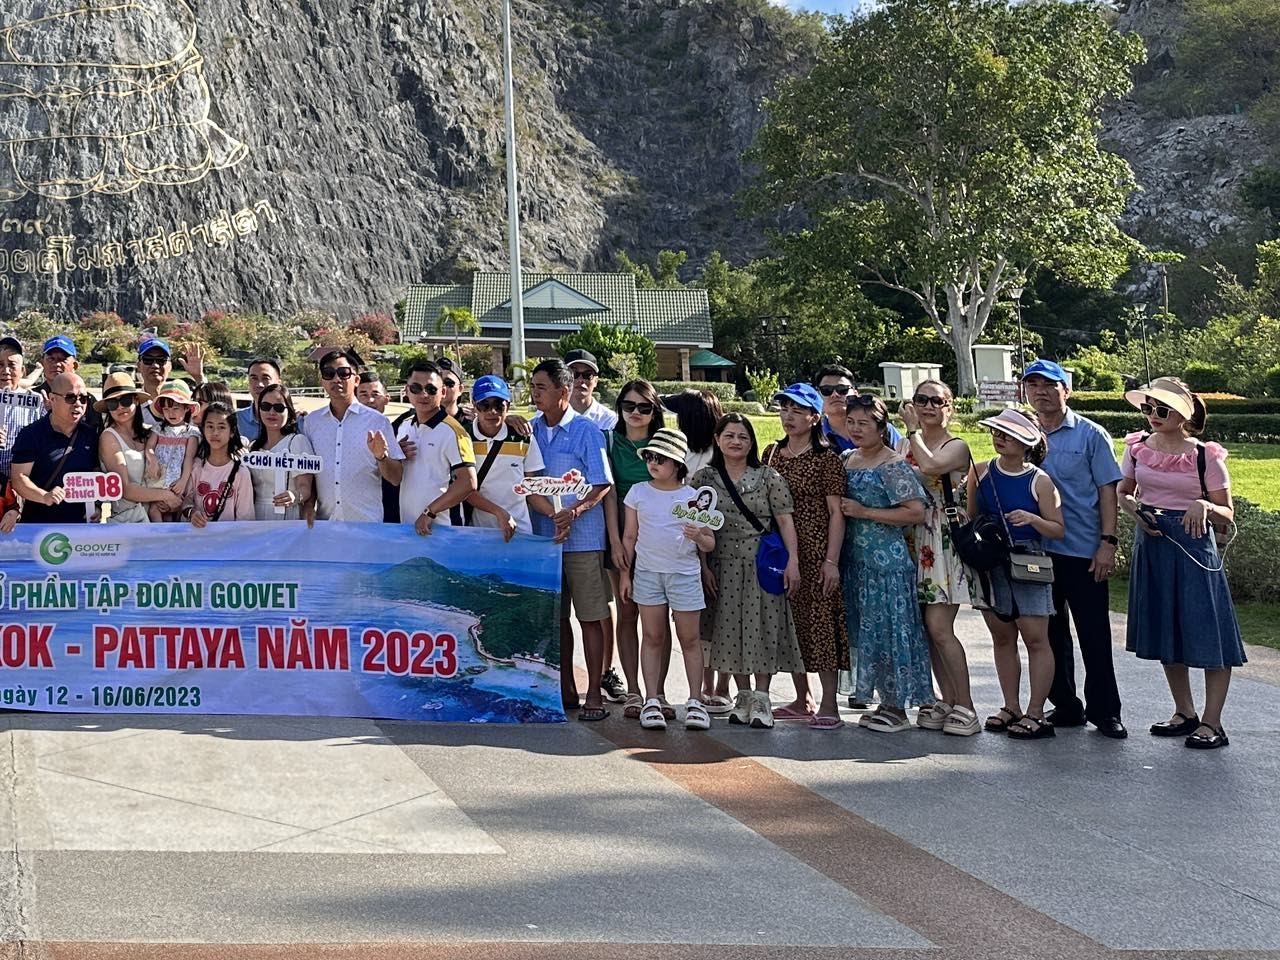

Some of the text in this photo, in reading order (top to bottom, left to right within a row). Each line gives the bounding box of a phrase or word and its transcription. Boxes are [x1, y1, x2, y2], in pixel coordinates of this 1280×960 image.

[95, 475, 121, 497] 18
[74, 543, 121, 552] GOOVET
[11, 574, 76, 608] PHẦN
[84, 578, 128, 613] TẬP
[136, 576, 202, 608] ĐOÀN
[211, 582, 299, 608] GOOVET
[66, 645, 81, 655] -
[94, 626, 245, 669] PATTAYA
[258, 618, 349, 670] NĂM
[362, 630, 458, 676] 2023
[45, 686, 68, 705] 12
[91, 686, 201, 707] 16/06/2023
